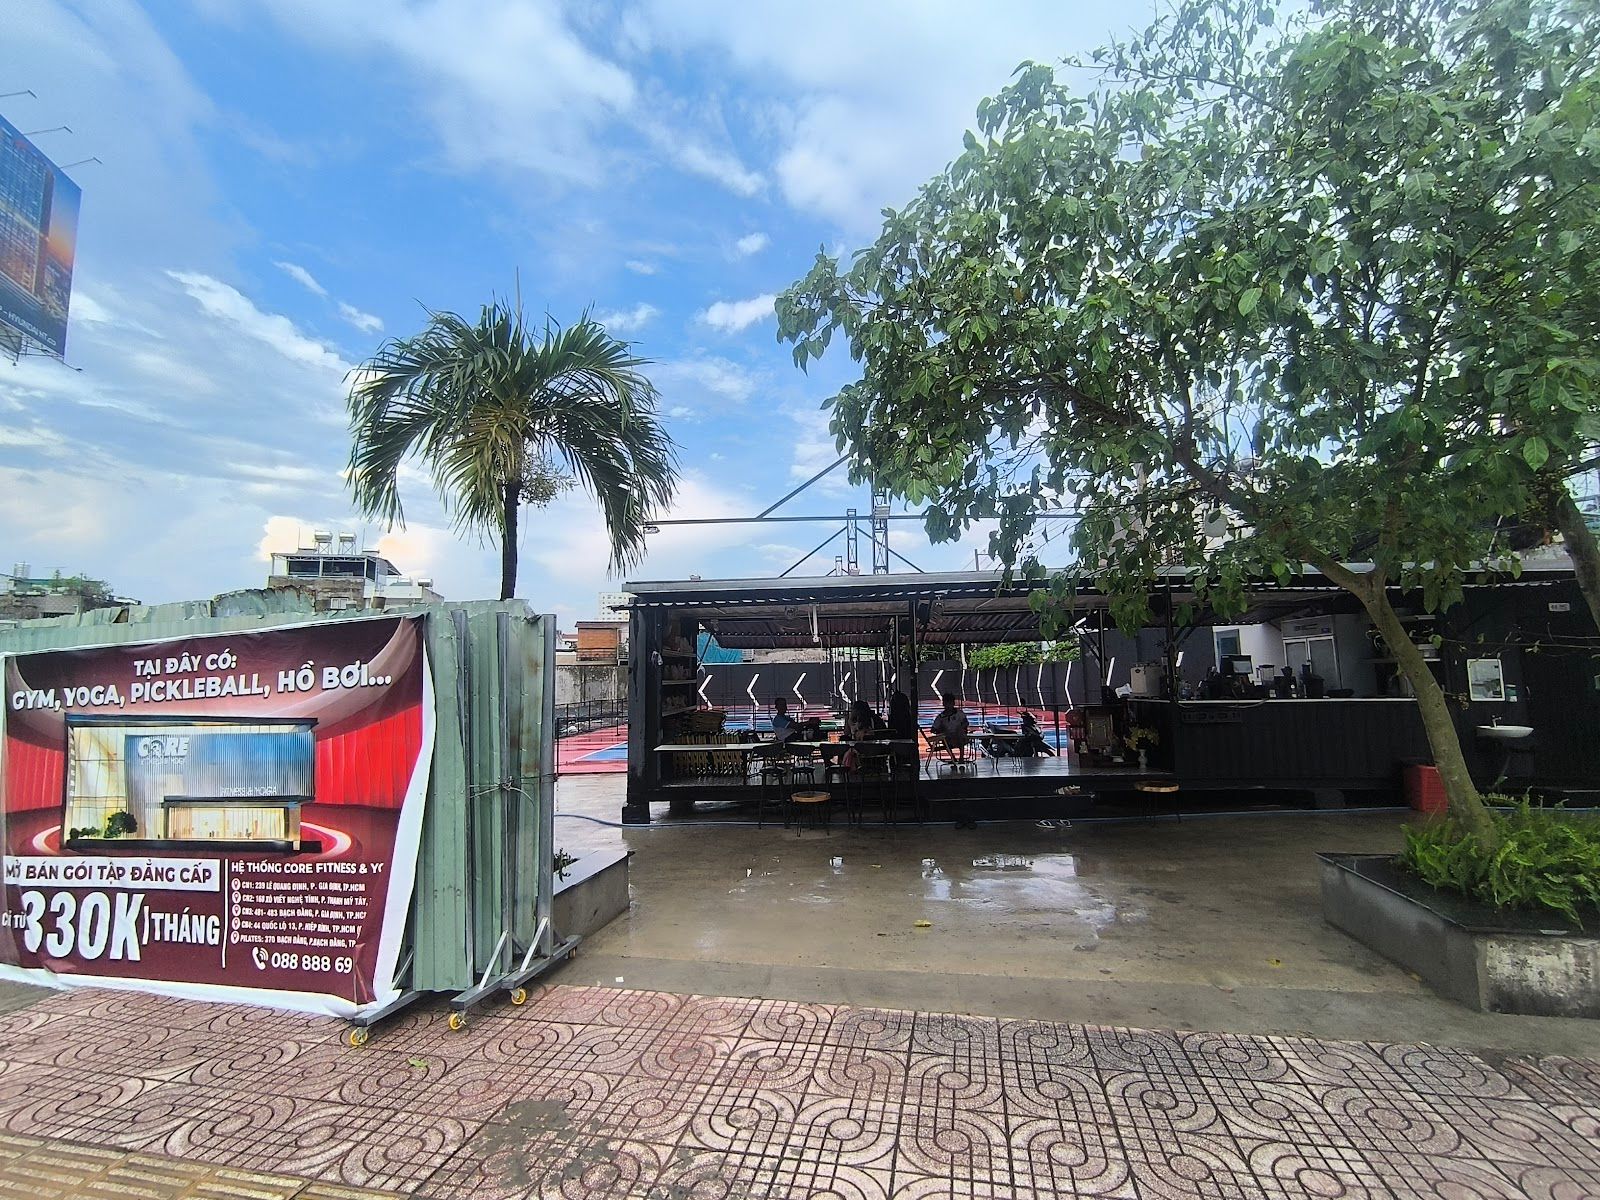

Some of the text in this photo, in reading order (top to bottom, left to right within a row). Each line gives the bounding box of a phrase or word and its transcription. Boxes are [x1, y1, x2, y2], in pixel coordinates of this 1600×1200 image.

[134, 648, 237, 680] TẠI ĐÂY CÓ:
[12, 659, 392, 711] GYM, YOGA, PICKLEBALL, HỒ BƠI...
[25, 861, 59, 880] BÁN
[63, 861, 93, 880] GÓI
[97, 861, 126, 885] TẬP
[130, 858, 176, 882] ĐẲNG
[179, 862, 213, 884] CẤP
[231, 860, 245, 875] HỆ
[246, 859, 282, 874] THỐNG
[283, 863, 314, 874] CORE
[315, 862, 357, 874] FITNESS
[359, 863, 368, 874] &
[21, 890, 146, 961] 330K
[271, 952, 353, 974] 088 888 69
